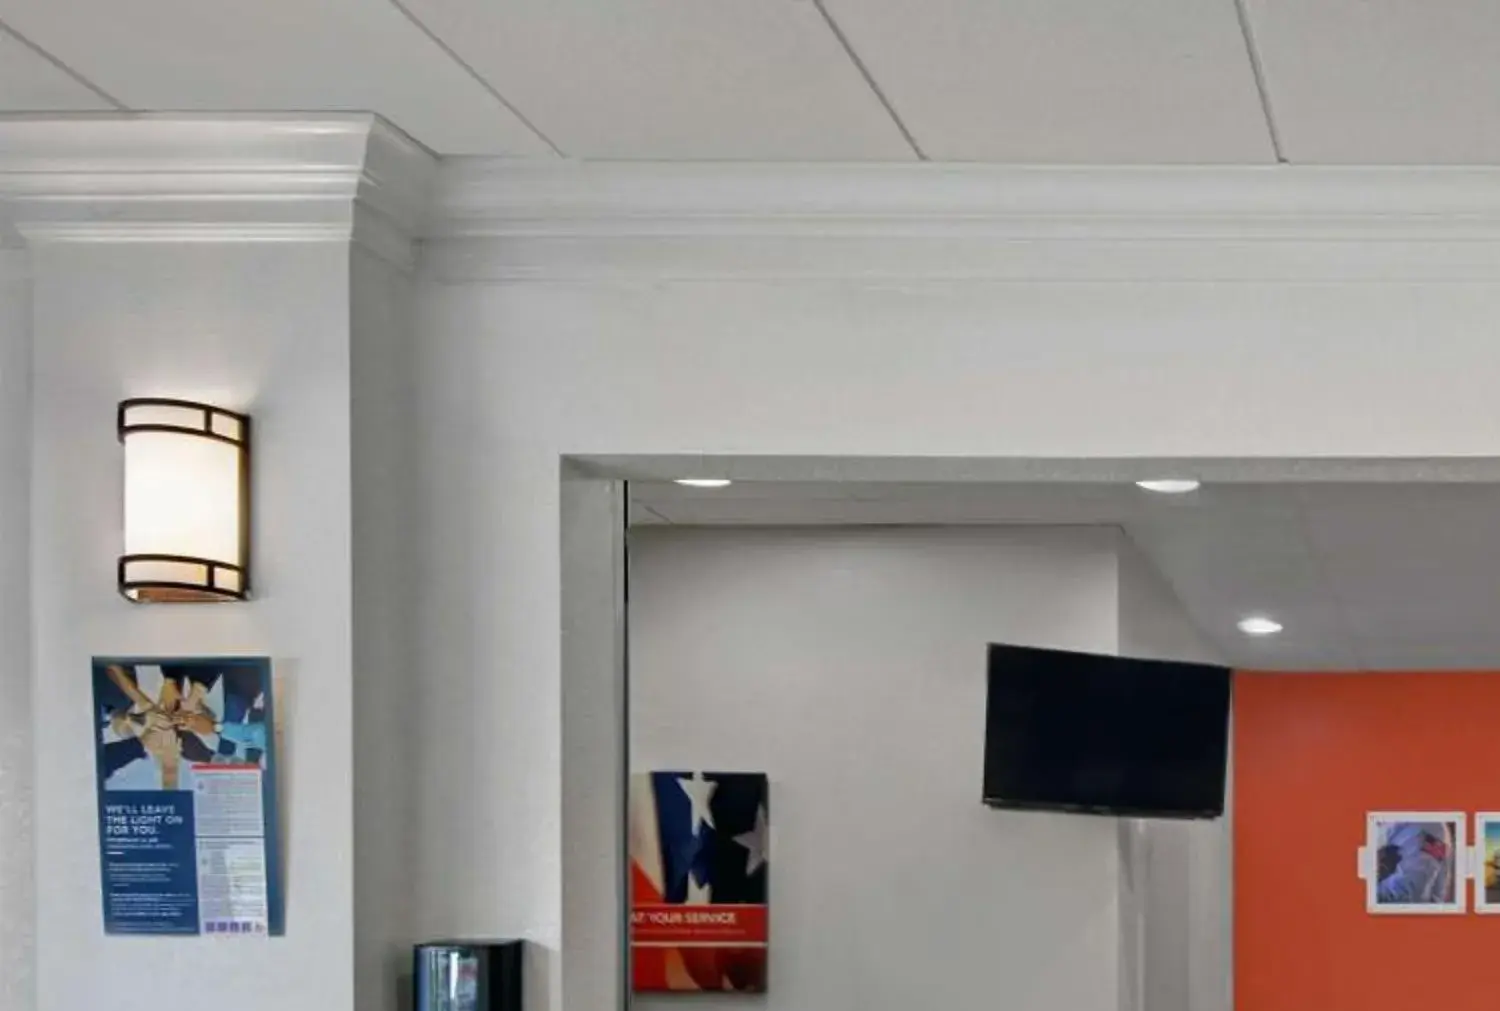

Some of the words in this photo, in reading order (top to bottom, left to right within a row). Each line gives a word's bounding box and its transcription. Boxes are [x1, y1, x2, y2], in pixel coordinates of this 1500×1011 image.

[141, 804, 175, 814] LEAVE
[105, 815, 127, 824] THE
[131, 815, 162, 824] LIGHT
[165, 815, 183, 824] ON
[106, 825, 128, 835] FOR
[647, 912, 682, 924] YOUR
[684, 912, 736, 924] SERVICE
